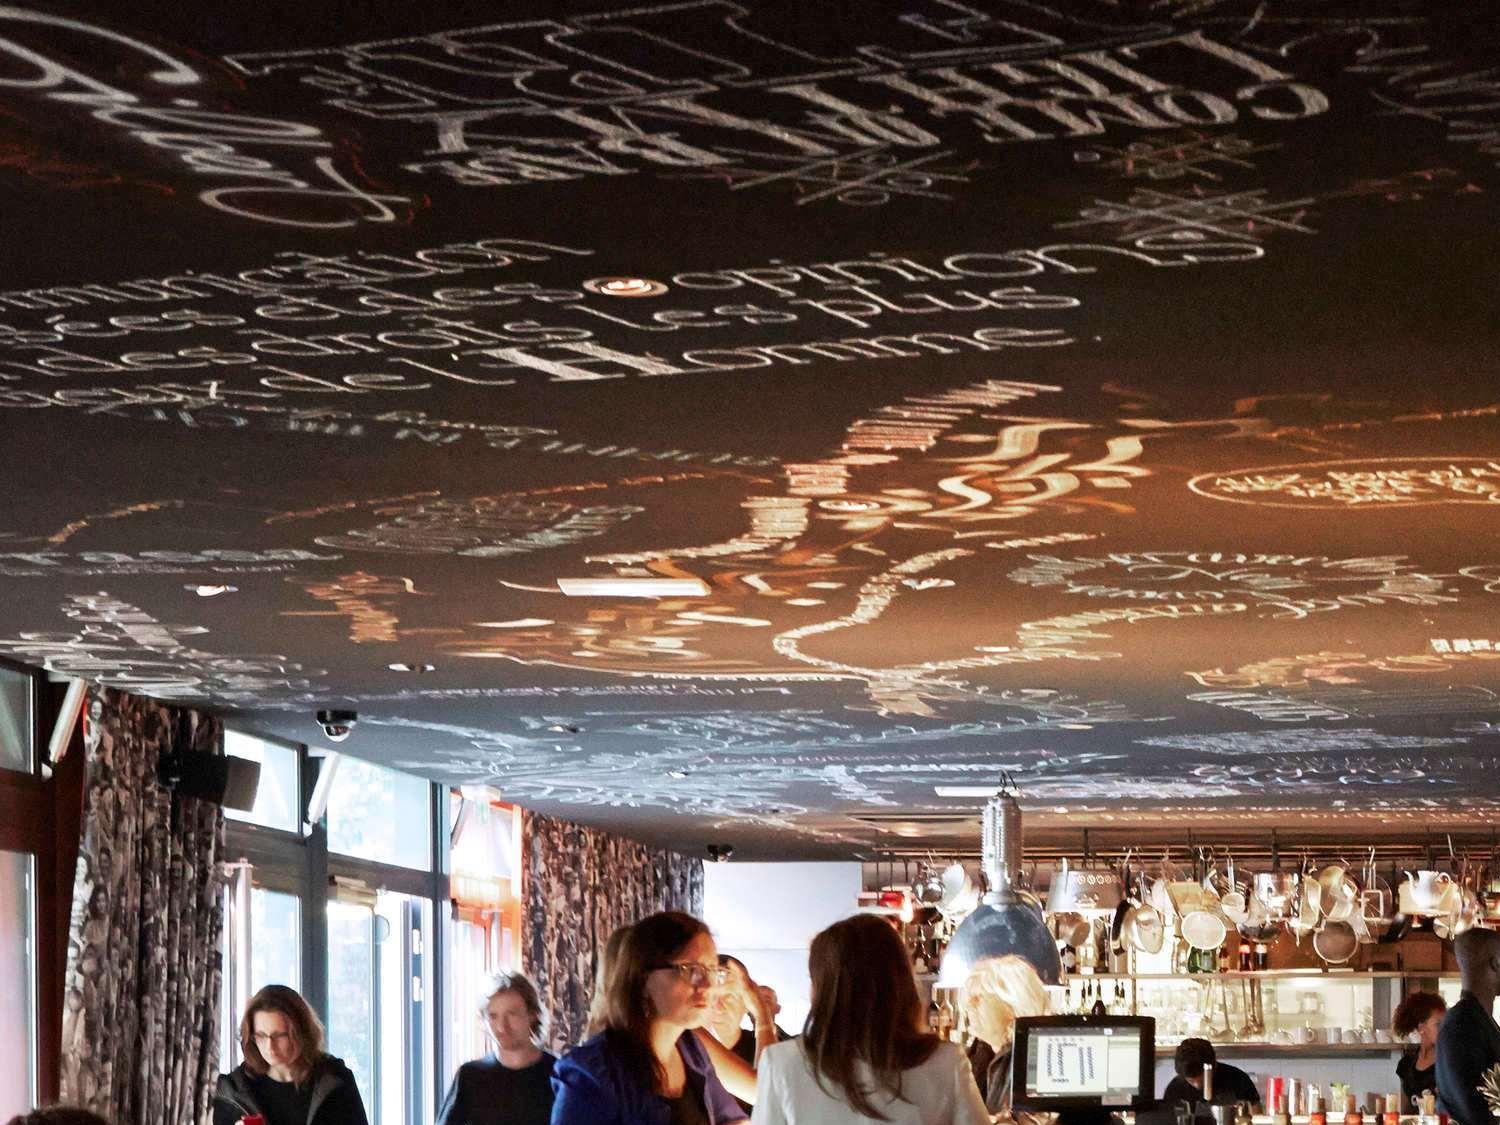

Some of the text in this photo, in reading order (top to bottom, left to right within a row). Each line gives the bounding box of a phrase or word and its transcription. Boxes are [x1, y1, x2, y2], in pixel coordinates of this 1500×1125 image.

[239, 314, 594, 356] droits
[565, 303, 798, 331] les
[788, 284, 1081, 328] plus
[252, 364, 432, 393] de
